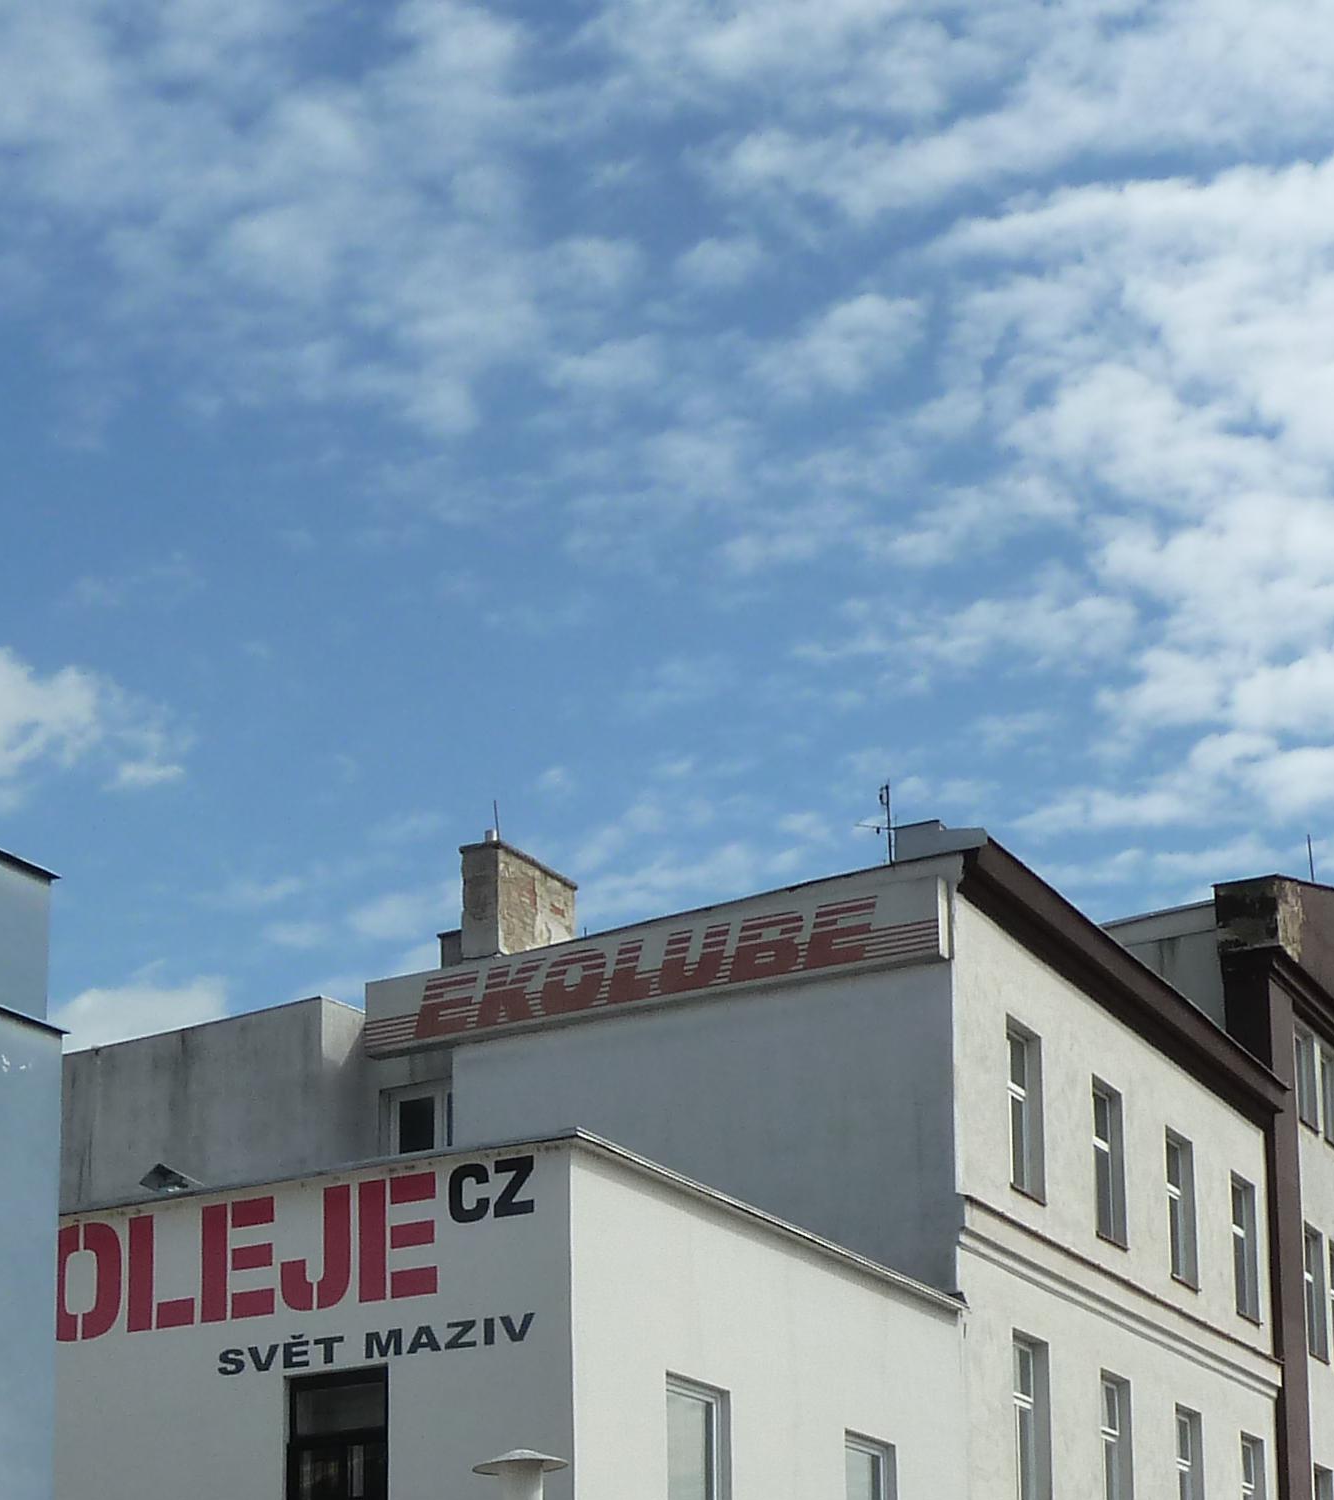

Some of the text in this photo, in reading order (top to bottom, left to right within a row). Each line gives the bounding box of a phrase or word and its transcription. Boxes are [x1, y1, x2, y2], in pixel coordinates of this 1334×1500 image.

[414, 895, 879, 1040] EKOLUBE
[55, 1155, 535, 1342] OLEJE CZ
[217, 1312, 535, 1377] SVĚT MAZIV
